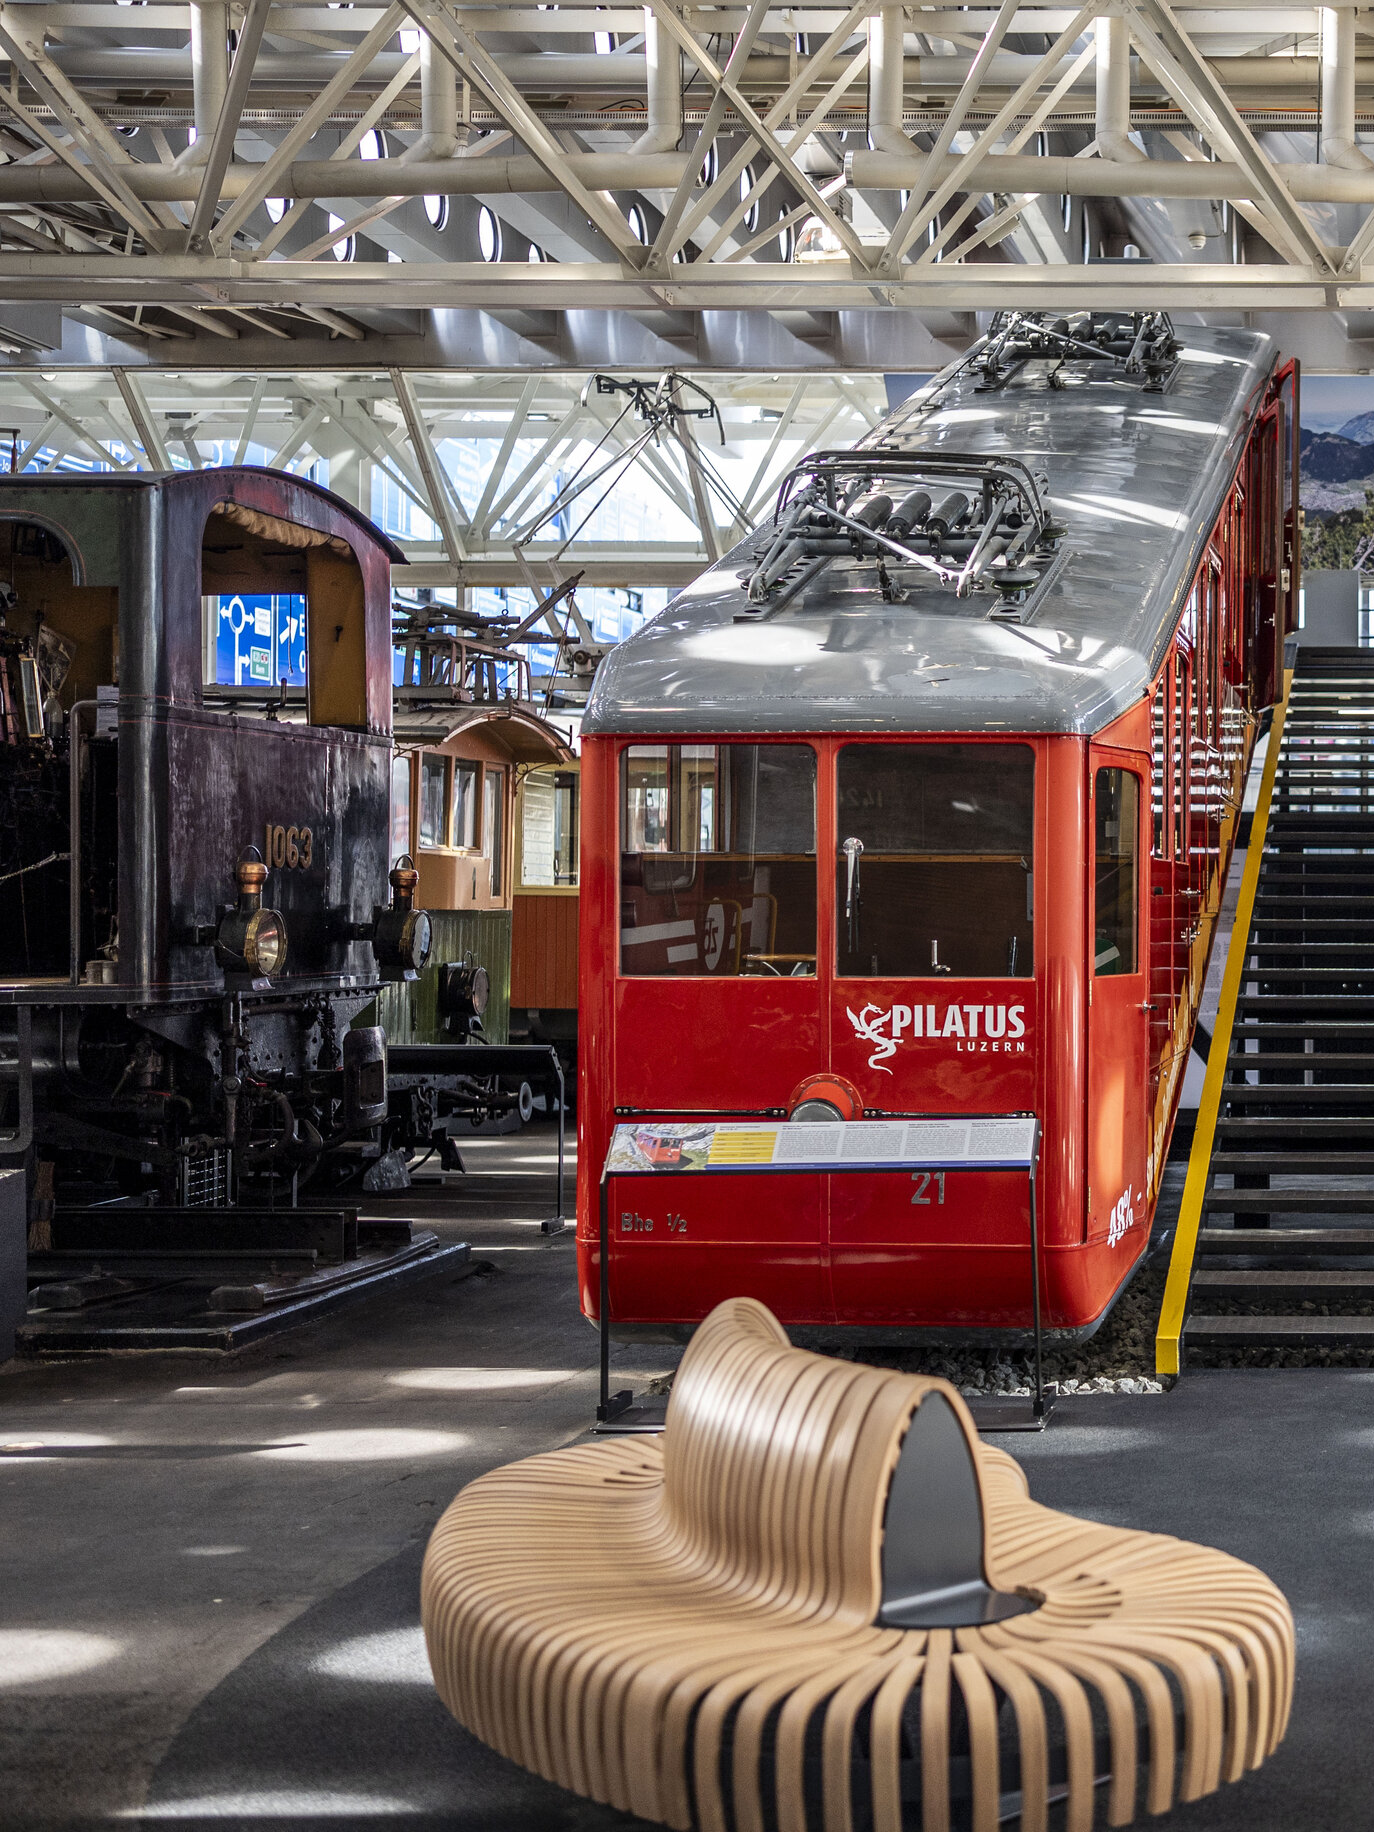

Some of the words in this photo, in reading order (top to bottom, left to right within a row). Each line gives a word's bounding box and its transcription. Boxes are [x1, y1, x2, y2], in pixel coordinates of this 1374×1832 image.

[265, 824, 313, 869] 1063
[891, 1004, 1026, 1038] PILATUS
[956, 1041, 1026, 1052] LUZERN
[911, 1172, 945, 1205] 21
[1106, 1183, 1134, 1249] 48%
